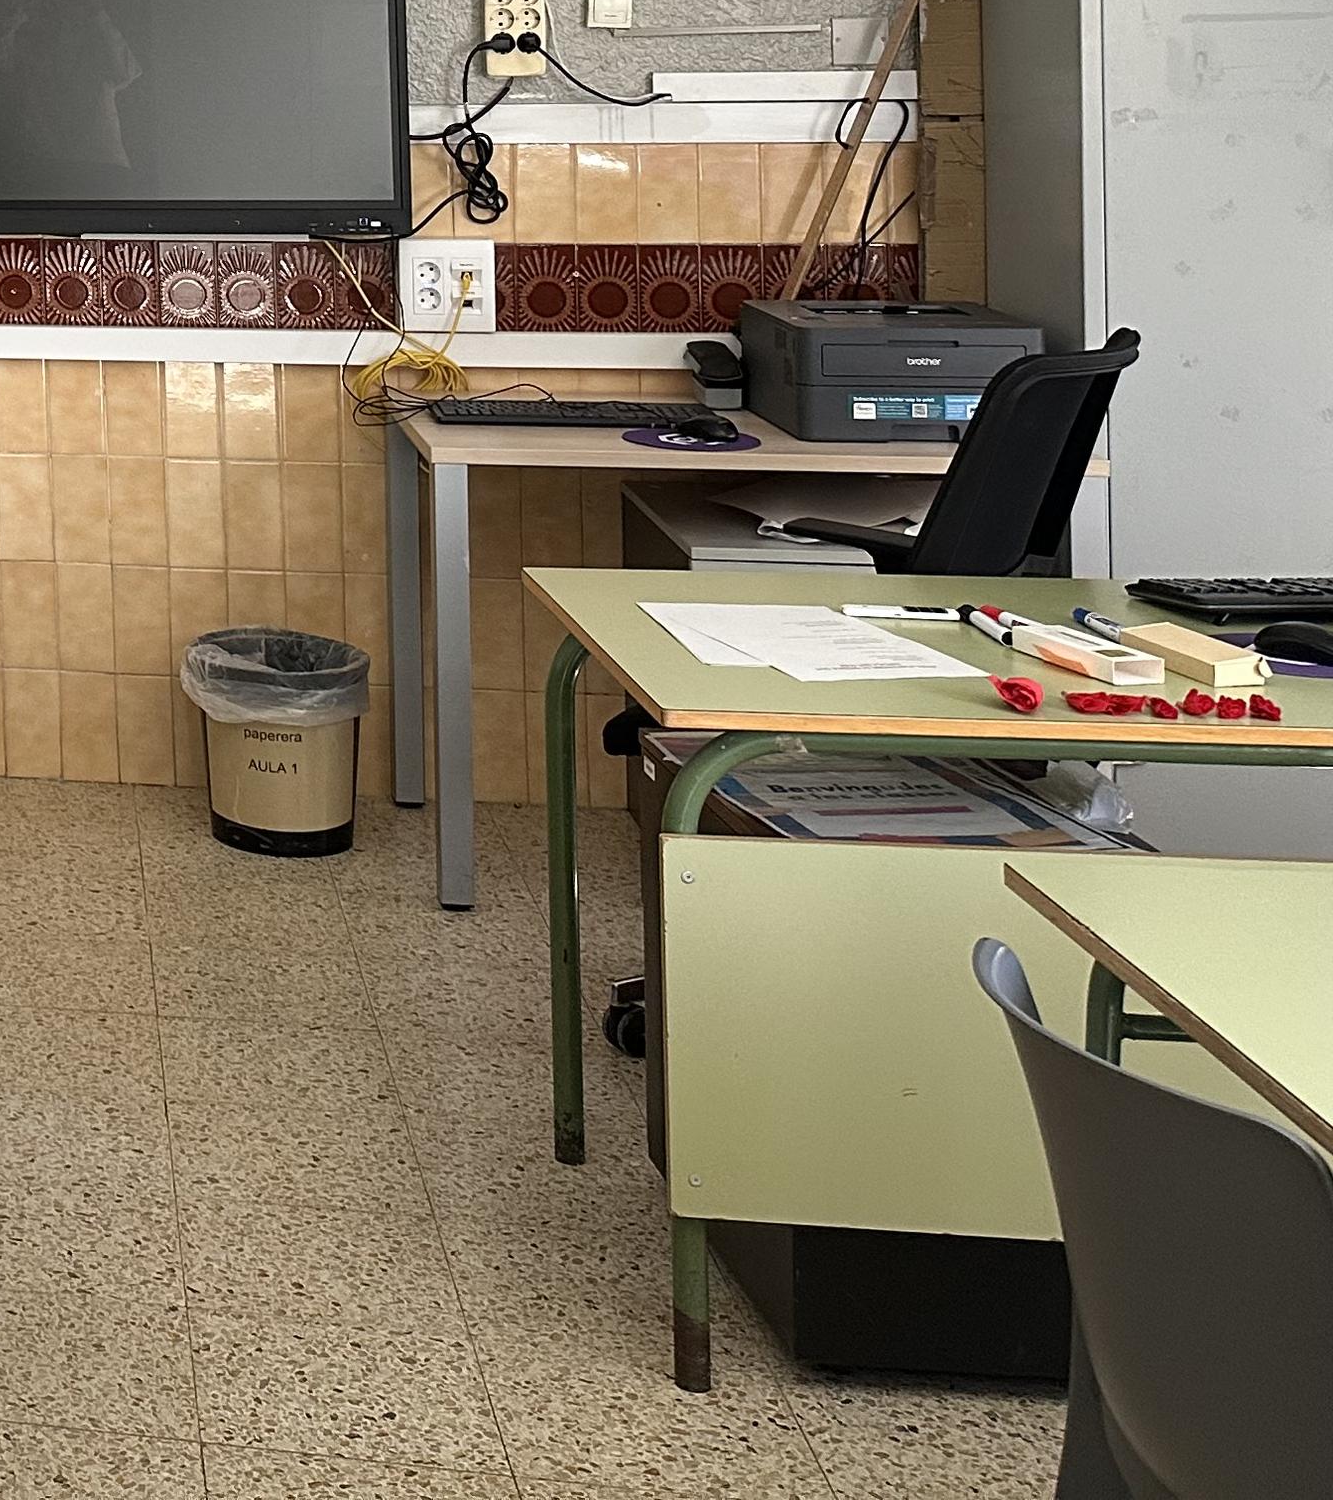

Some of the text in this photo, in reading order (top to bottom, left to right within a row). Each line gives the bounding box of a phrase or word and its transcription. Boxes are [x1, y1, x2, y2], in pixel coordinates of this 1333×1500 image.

[907, 357, 941, 365] brother
[244, 728, 302, 743] paperera
[248, 759, 298, 774] AULA 1
